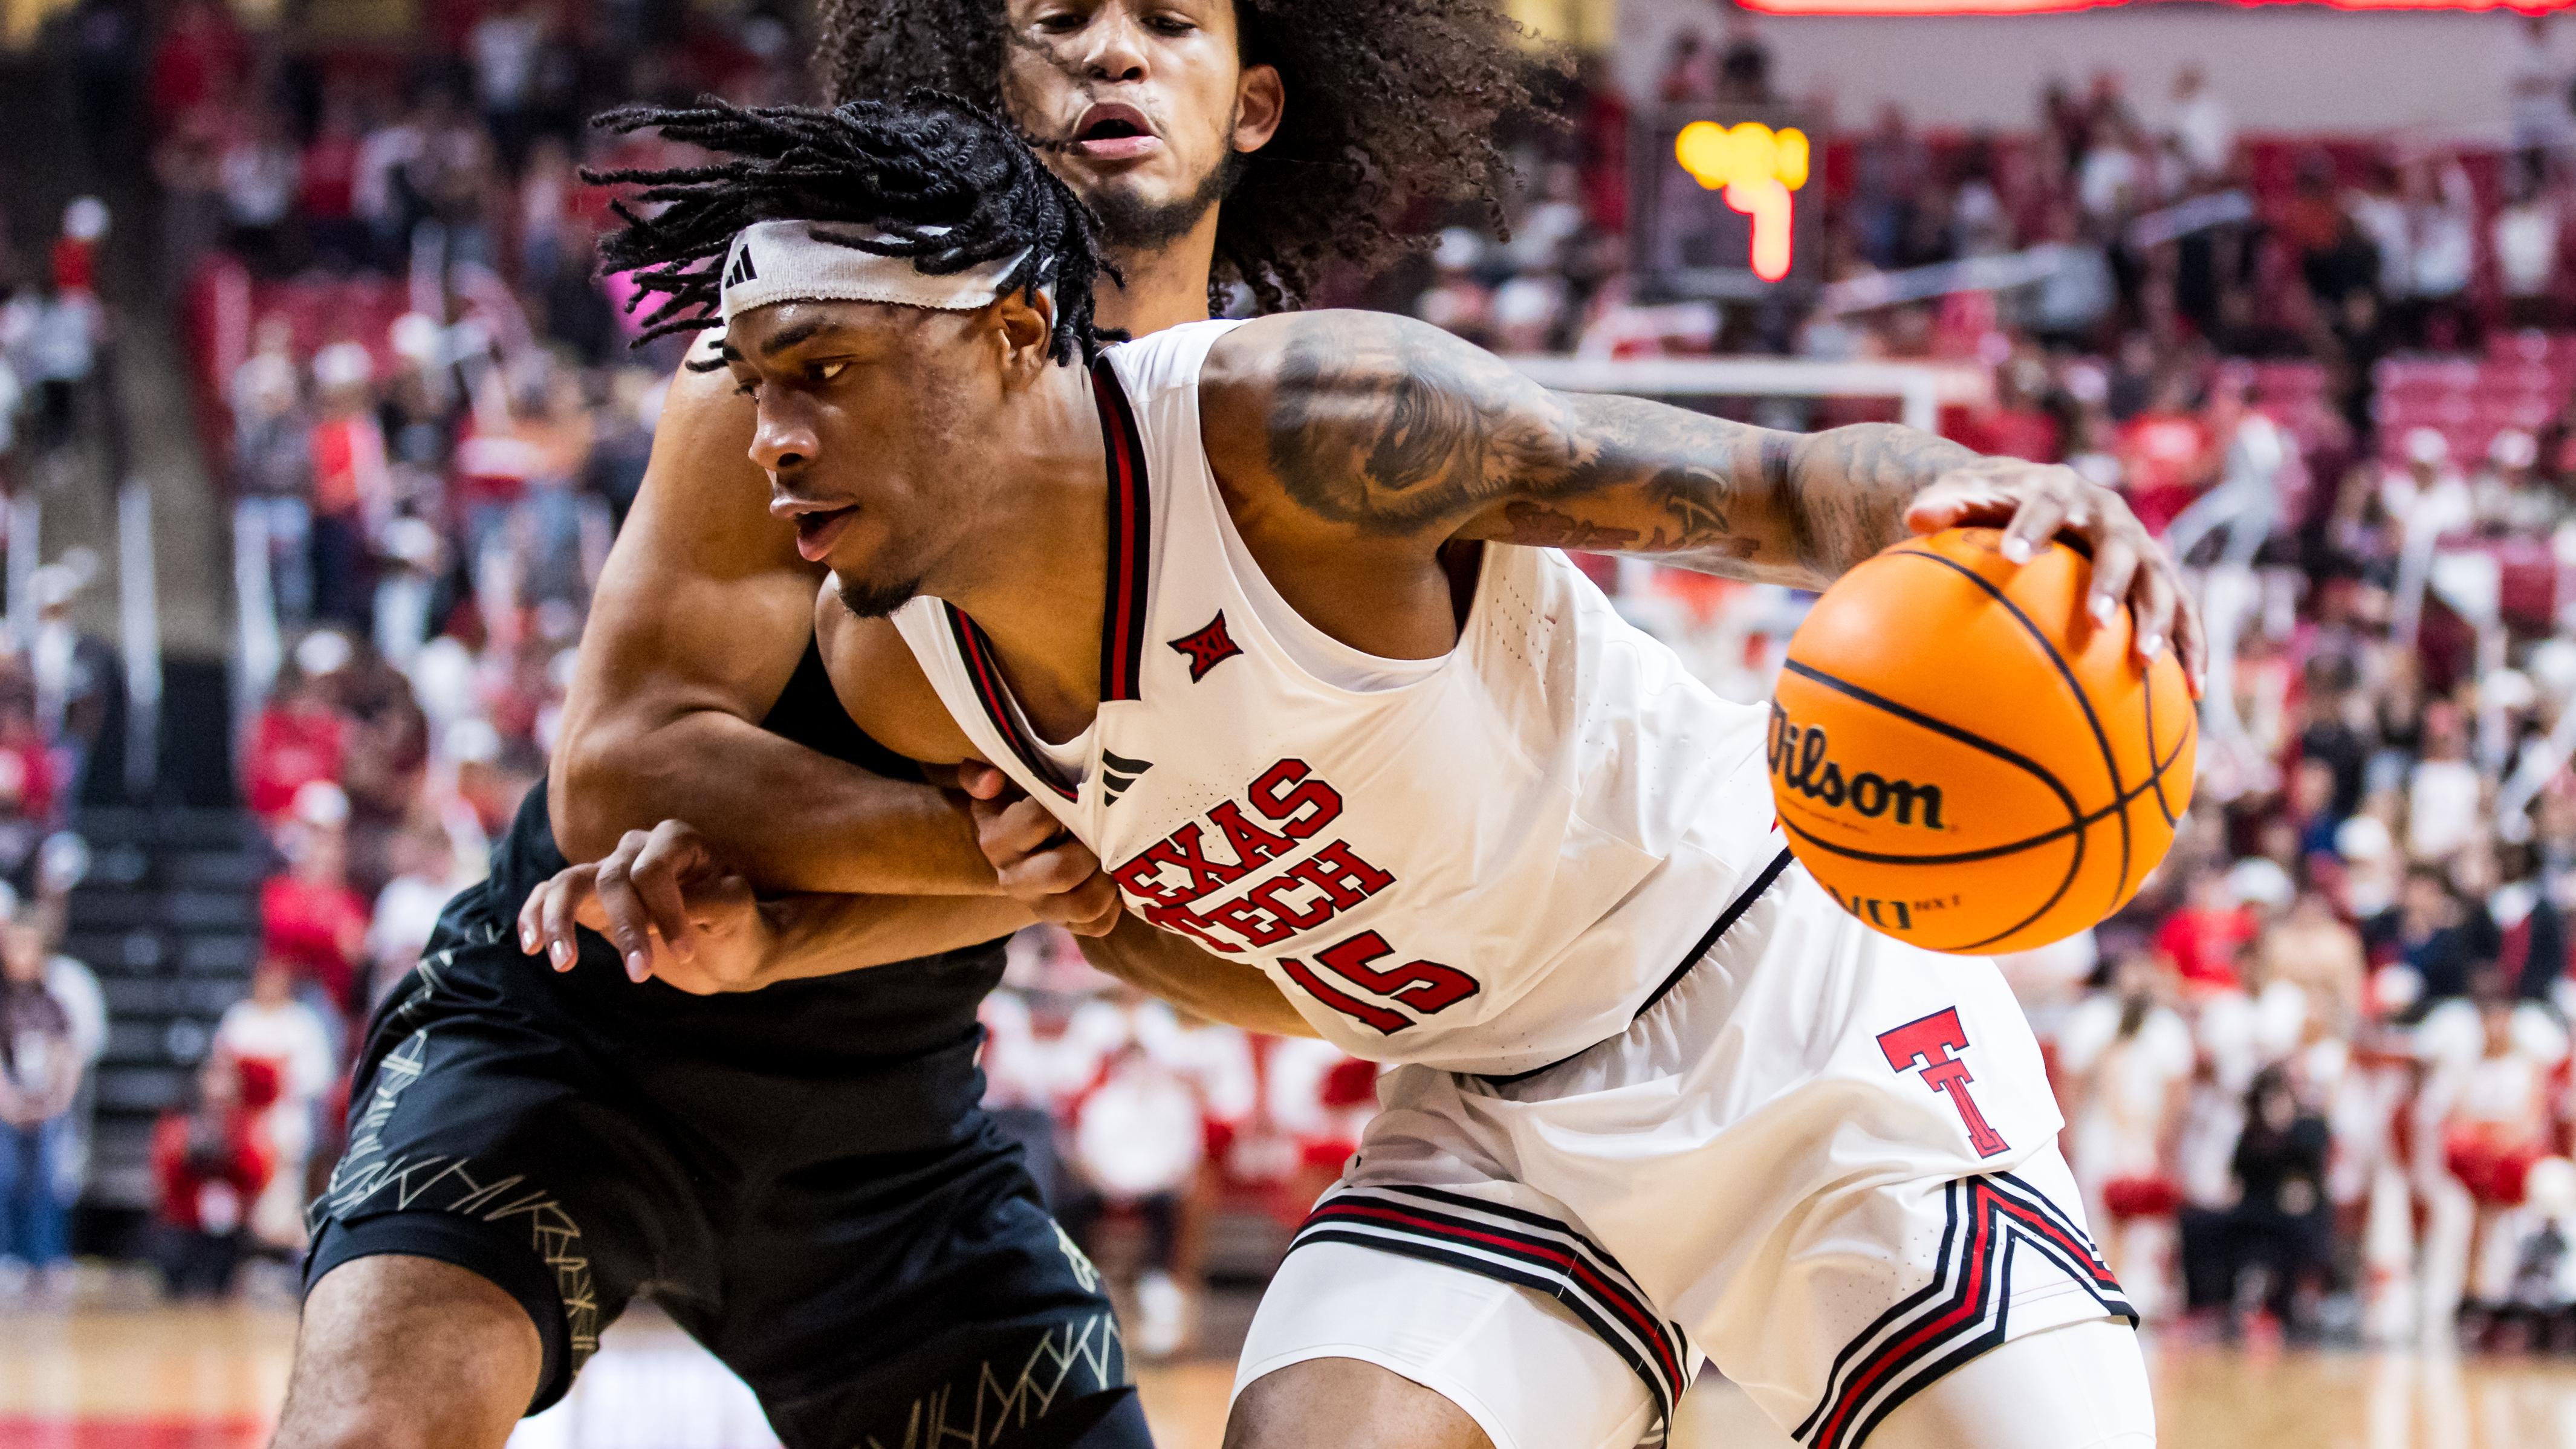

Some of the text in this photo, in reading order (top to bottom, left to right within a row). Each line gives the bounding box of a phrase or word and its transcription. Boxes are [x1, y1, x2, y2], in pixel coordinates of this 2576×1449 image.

[1111, 758, 1343, 907] EXAS
[1144, 838, 1397, 953] TECH
[1276, 929, 1480, 1036] 15
